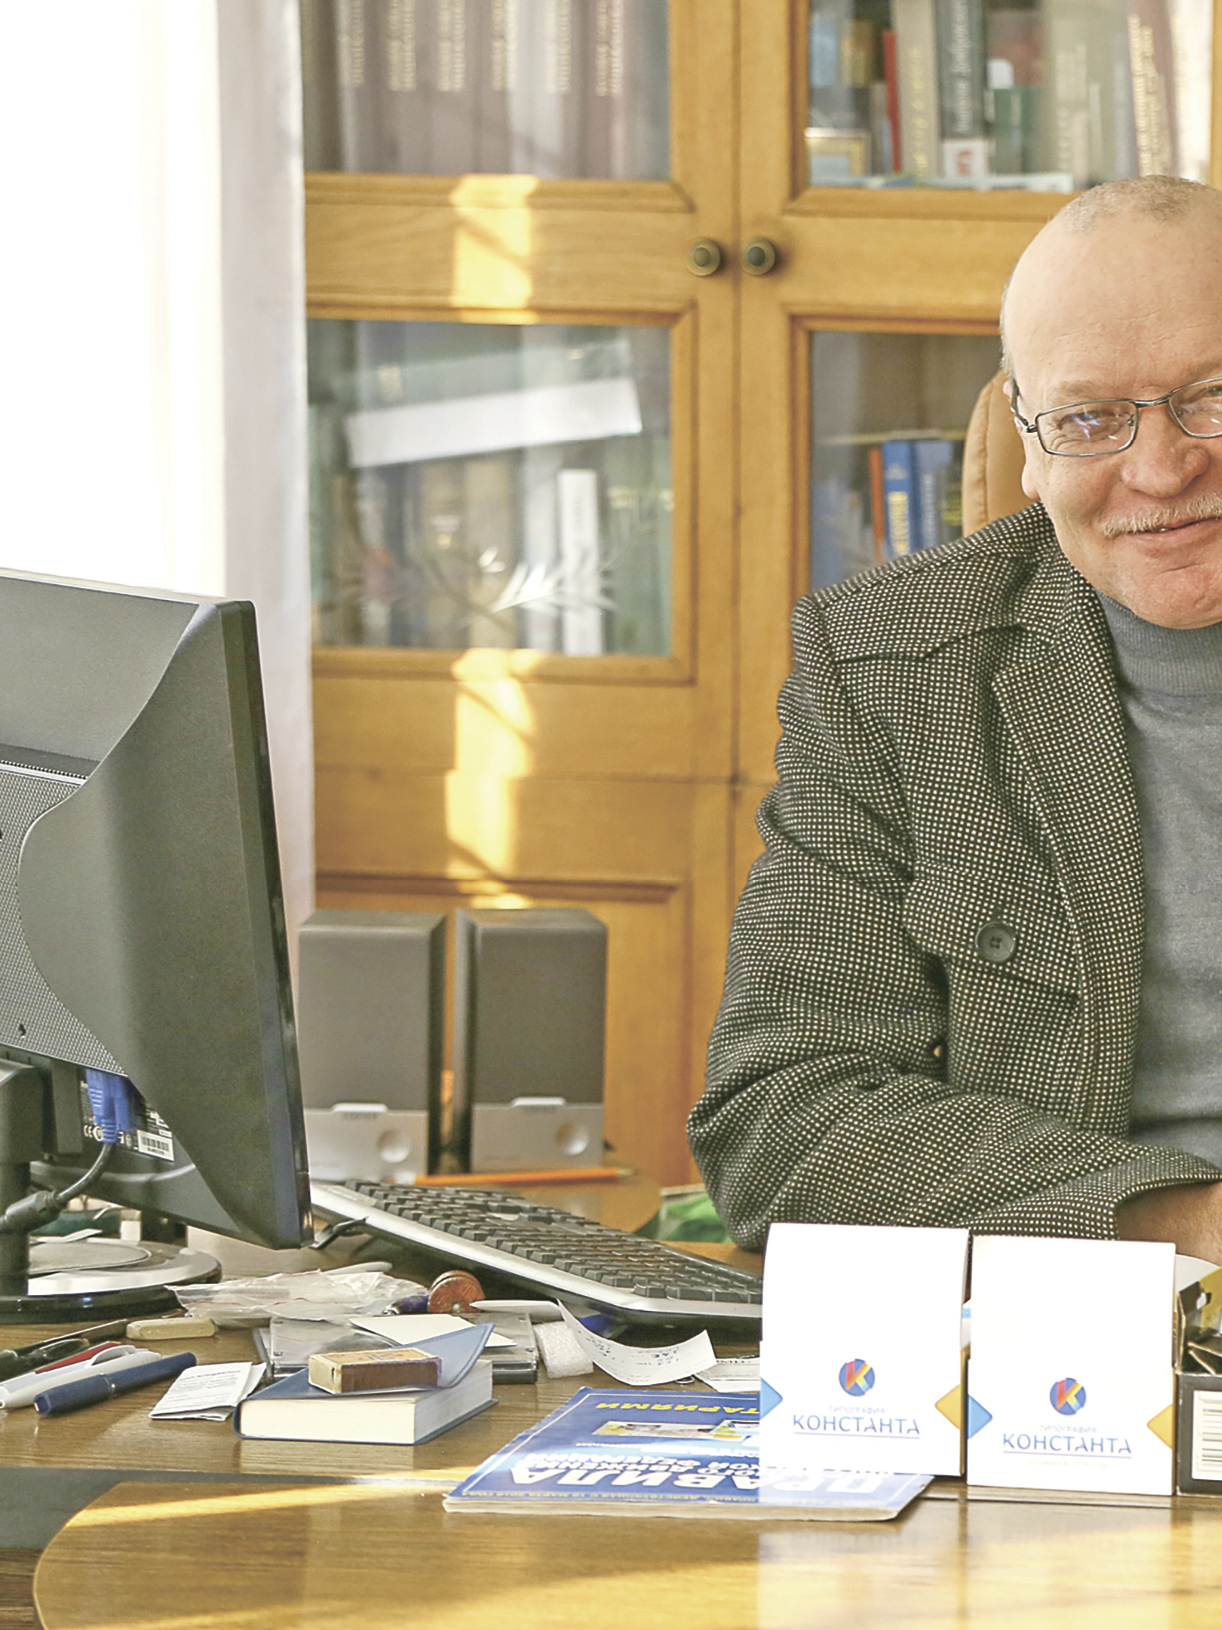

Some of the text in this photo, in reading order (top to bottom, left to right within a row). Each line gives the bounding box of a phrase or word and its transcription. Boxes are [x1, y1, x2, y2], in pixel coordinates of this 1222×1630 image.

[596, 1402, 760, 1415] ТАРИЯМИ
[829, 1405, 886, 1414] ТИПОГРАФИЯ
[793, 1414, 920, 1434] КОНСТАНТА
[1040, 1424, 1097, 1433] ТИПОГРАФИЯ
[1003, 1433, 1132, 1454] КОНСТАНТА
